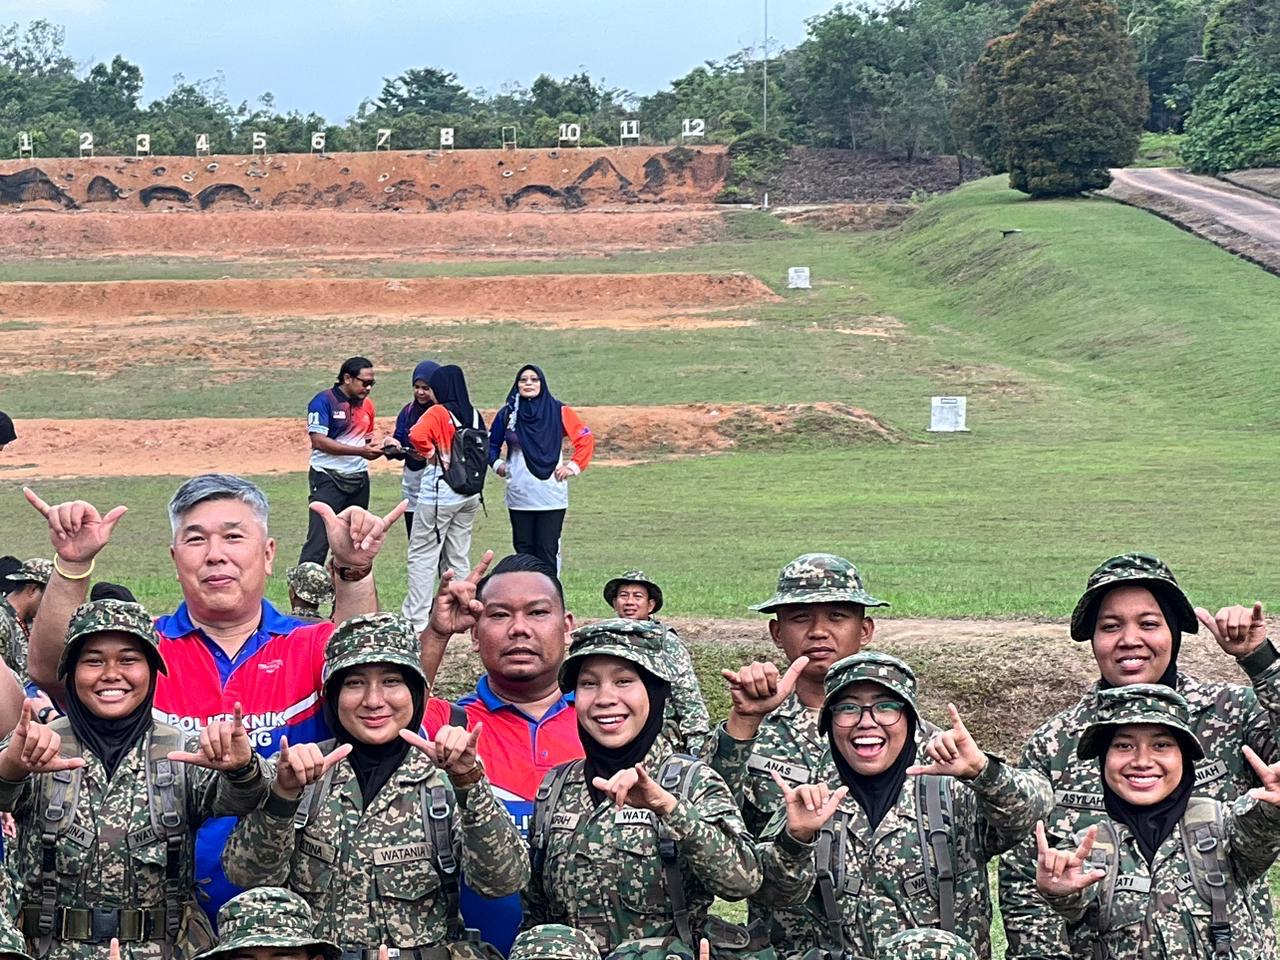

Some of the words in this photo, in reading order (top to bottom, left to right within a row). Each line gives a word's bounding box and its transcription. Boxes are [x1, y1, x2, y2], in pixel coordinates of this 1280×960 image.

[560, 124, 580, 141] 10
[620, 120, 639, 139] 11
[682, 119, 704, 137] 12
[21, 133, 32, 150] 1
[80, 133, 93, 149] 2
[137, 134, 150, 151] 3
[196, 134, 209, 151] 4
[253, 132, 266, 149] 5
[312, 132, 325, 149] 6
[377, 129, 391, 146] 7
[440, 128, 454, 146] 8
[764, 761, 792, 775] ANAS
